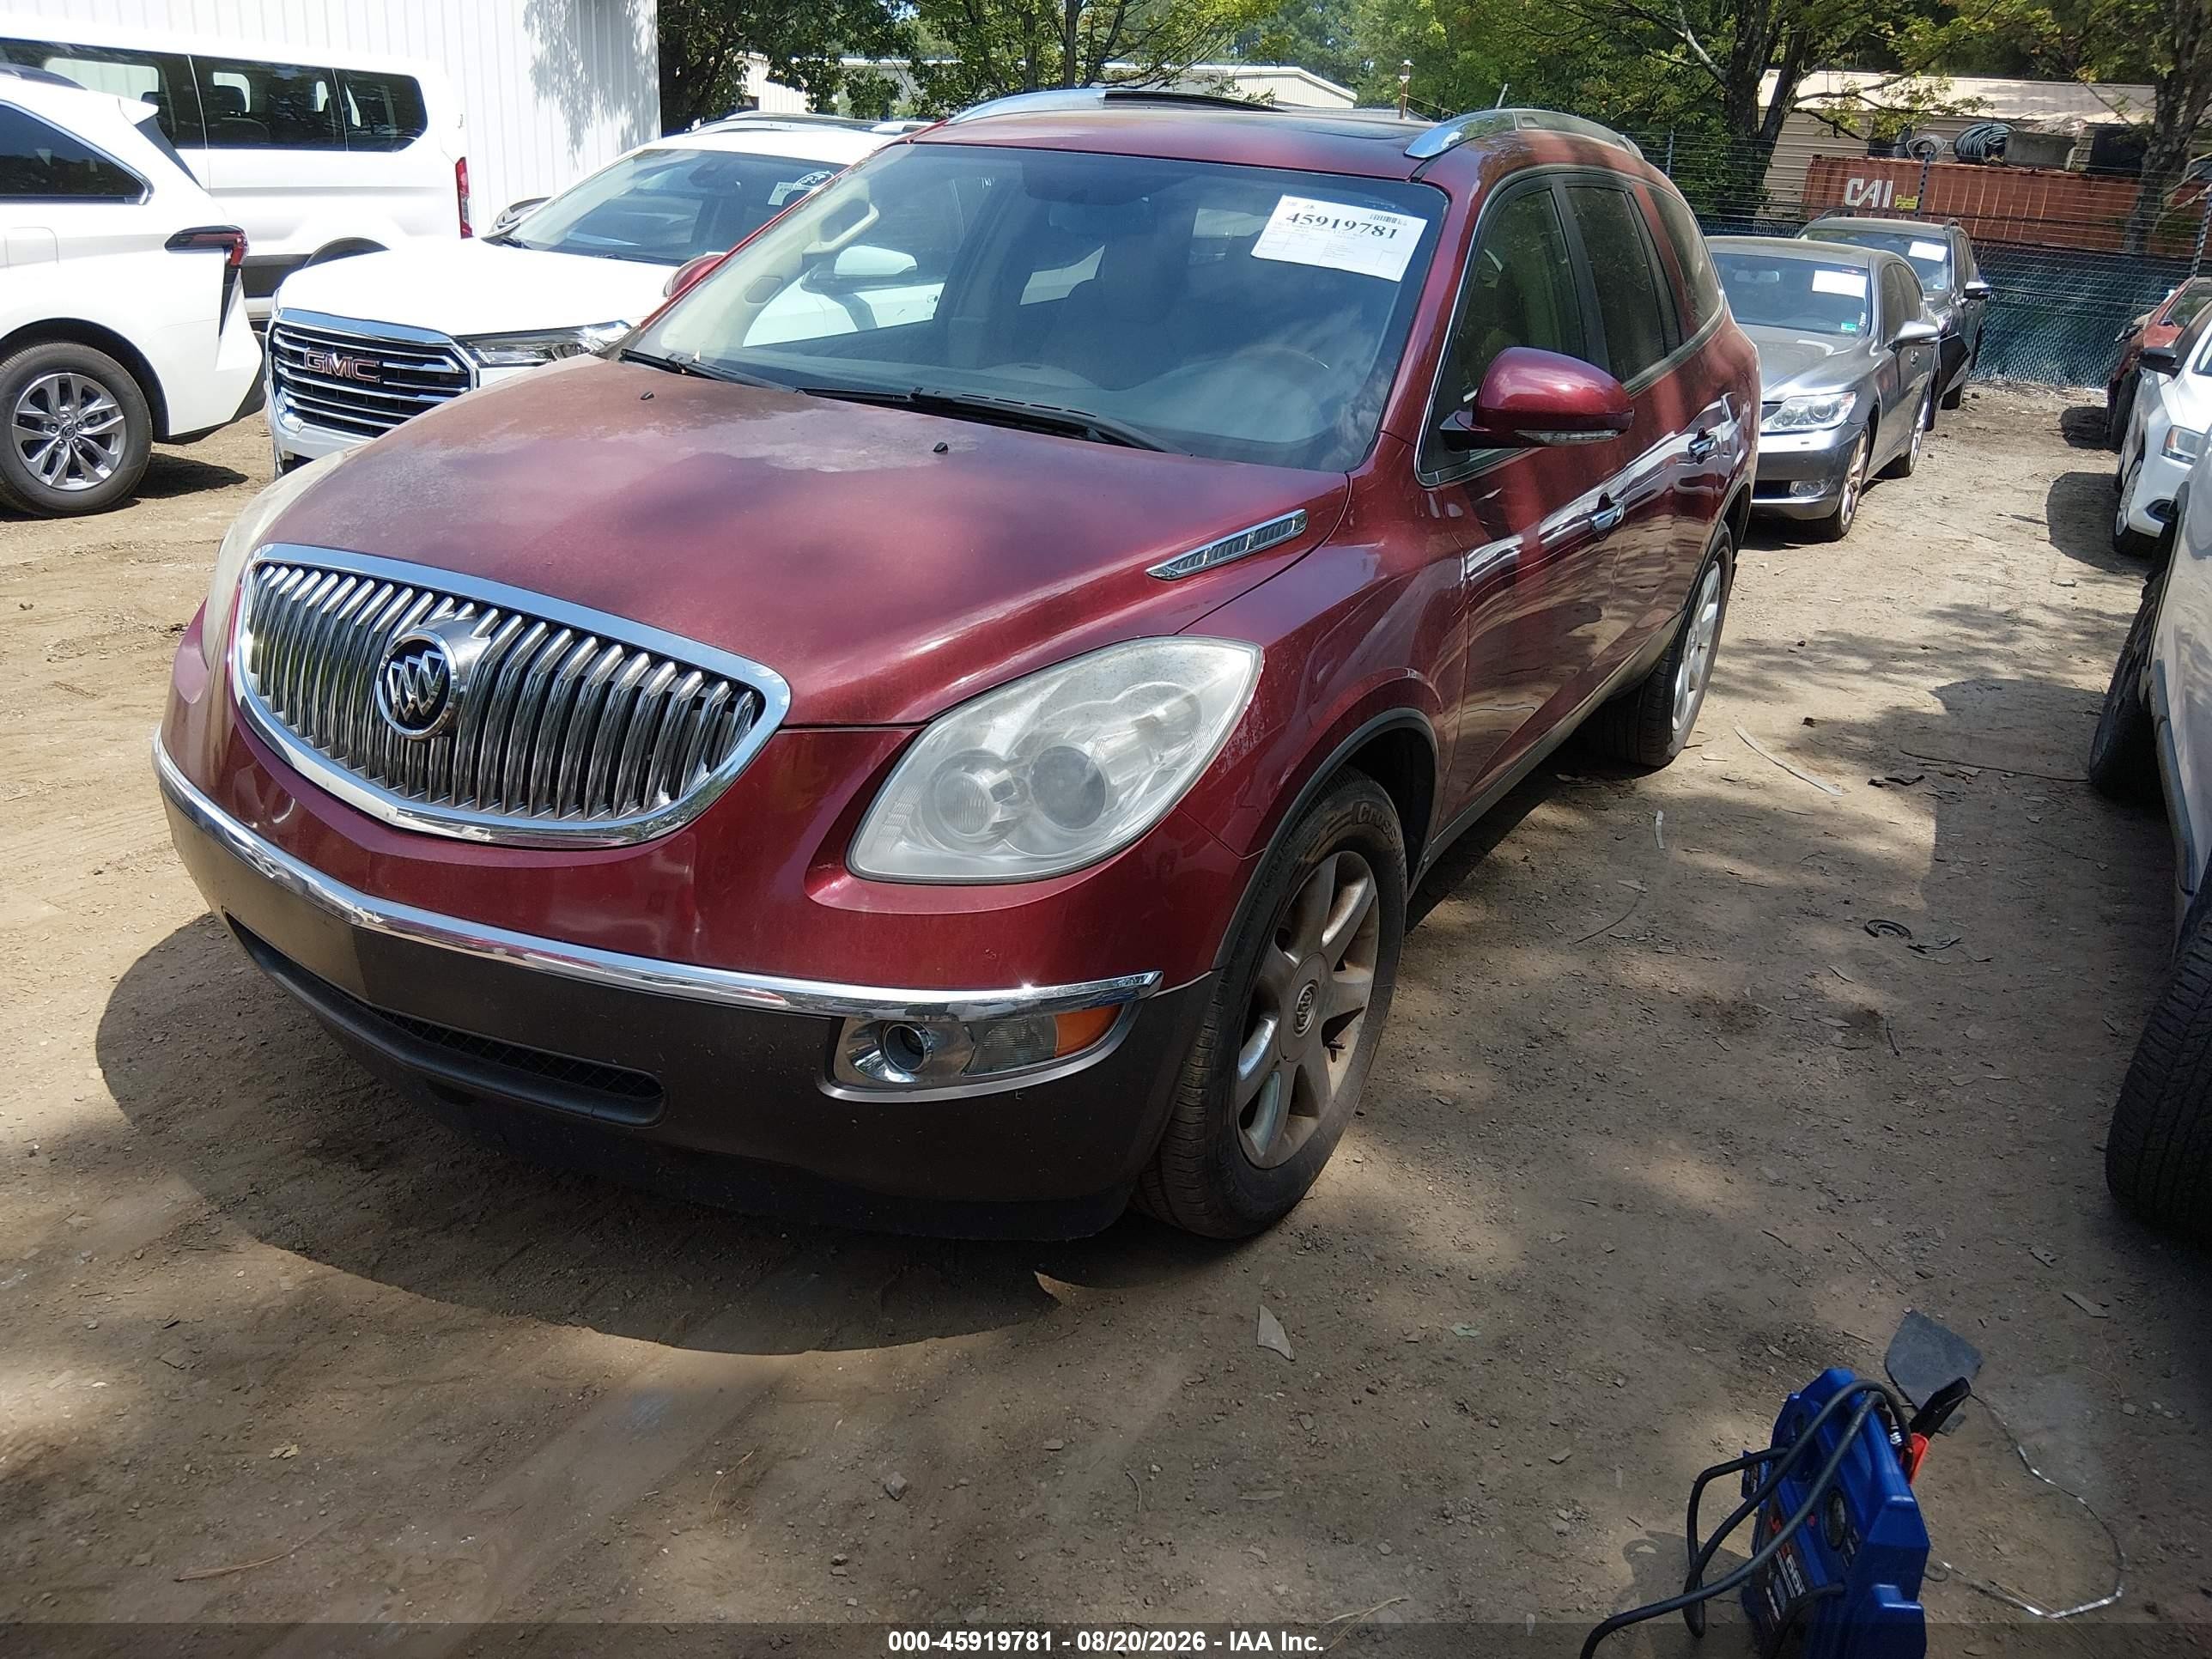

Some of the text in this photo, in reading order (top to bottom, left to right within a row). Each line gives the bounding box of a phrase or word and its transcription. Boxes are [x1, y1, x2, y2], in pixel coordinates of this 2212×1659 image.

[1844, 178, 1893, 208] CAI
[1285, 211, 1399, 240] 45919781
[304, 349, 380, 383] GMC
